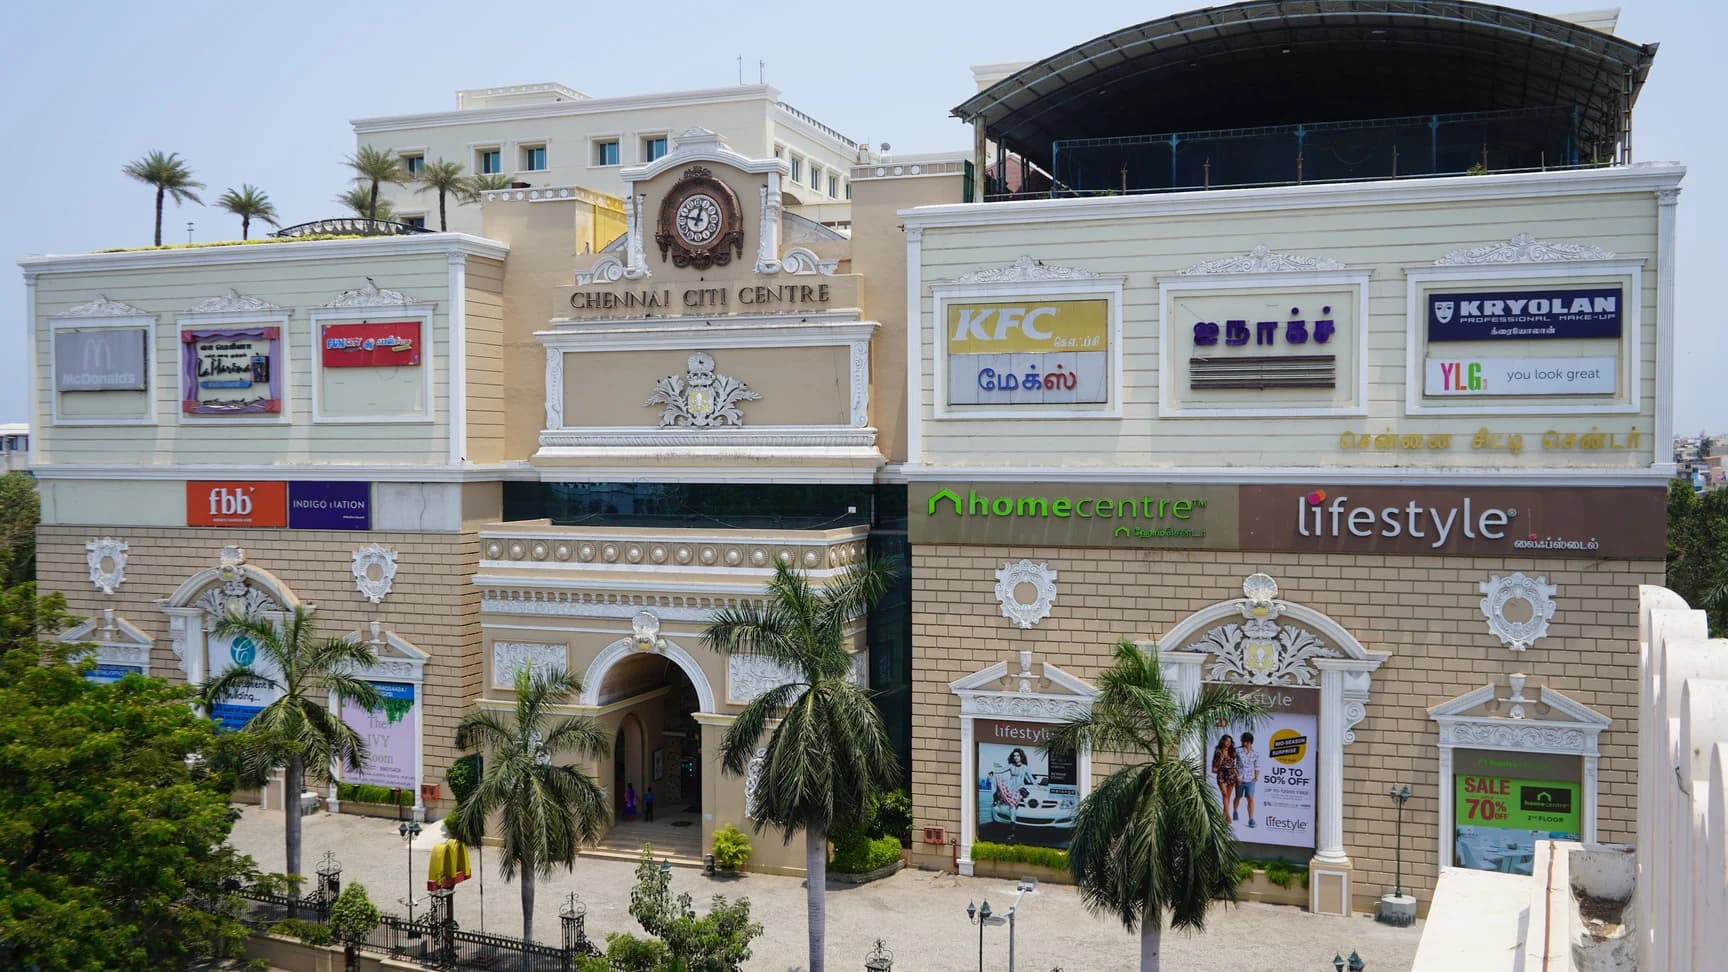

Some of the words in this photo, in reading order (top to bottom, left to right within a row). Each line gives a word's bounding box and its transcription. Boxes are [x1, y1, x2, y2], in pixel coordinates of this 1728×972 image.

[569, 289, 669, 309] CHENNAI
[683, 287, 728, 307] CITI
[738, 284, 829, 305] CENTRE
[1459, 297, 1616, 317] KRYOLAN
[952, 306, 1056, 341] KFC
[1460, 315, 1551, 323] PROFESSIONAL
[1559, 313, 1616, 321] MAKE-UP
[978, 364, 1077, 392] மேக்ஸ்
[1441, 362, 1482, 391] YLG
[1506, 370, 1531, 381] you
[1535, 368, 1562, 380] look
[1566, 367, 1600, 381] great
[209, 487, 252, 515] fbb
[293, 499, 327, 509] INDIGO
[968, 488, 1193, 519] homecentre
[1298, 490, 1509, 548] lifestyle
[1264, 776, 1286, 785] 50%
[1288, 777, 1310, 787] OFF
[1272, 767, 1286, 776] UP
[1289, 768, 1303, 777] TO
[1464, 776, 1511, 796] SALE
[1265, 815, 1307, 831] lifestyle
[1538, 815, 1564, 823] FLOOR
